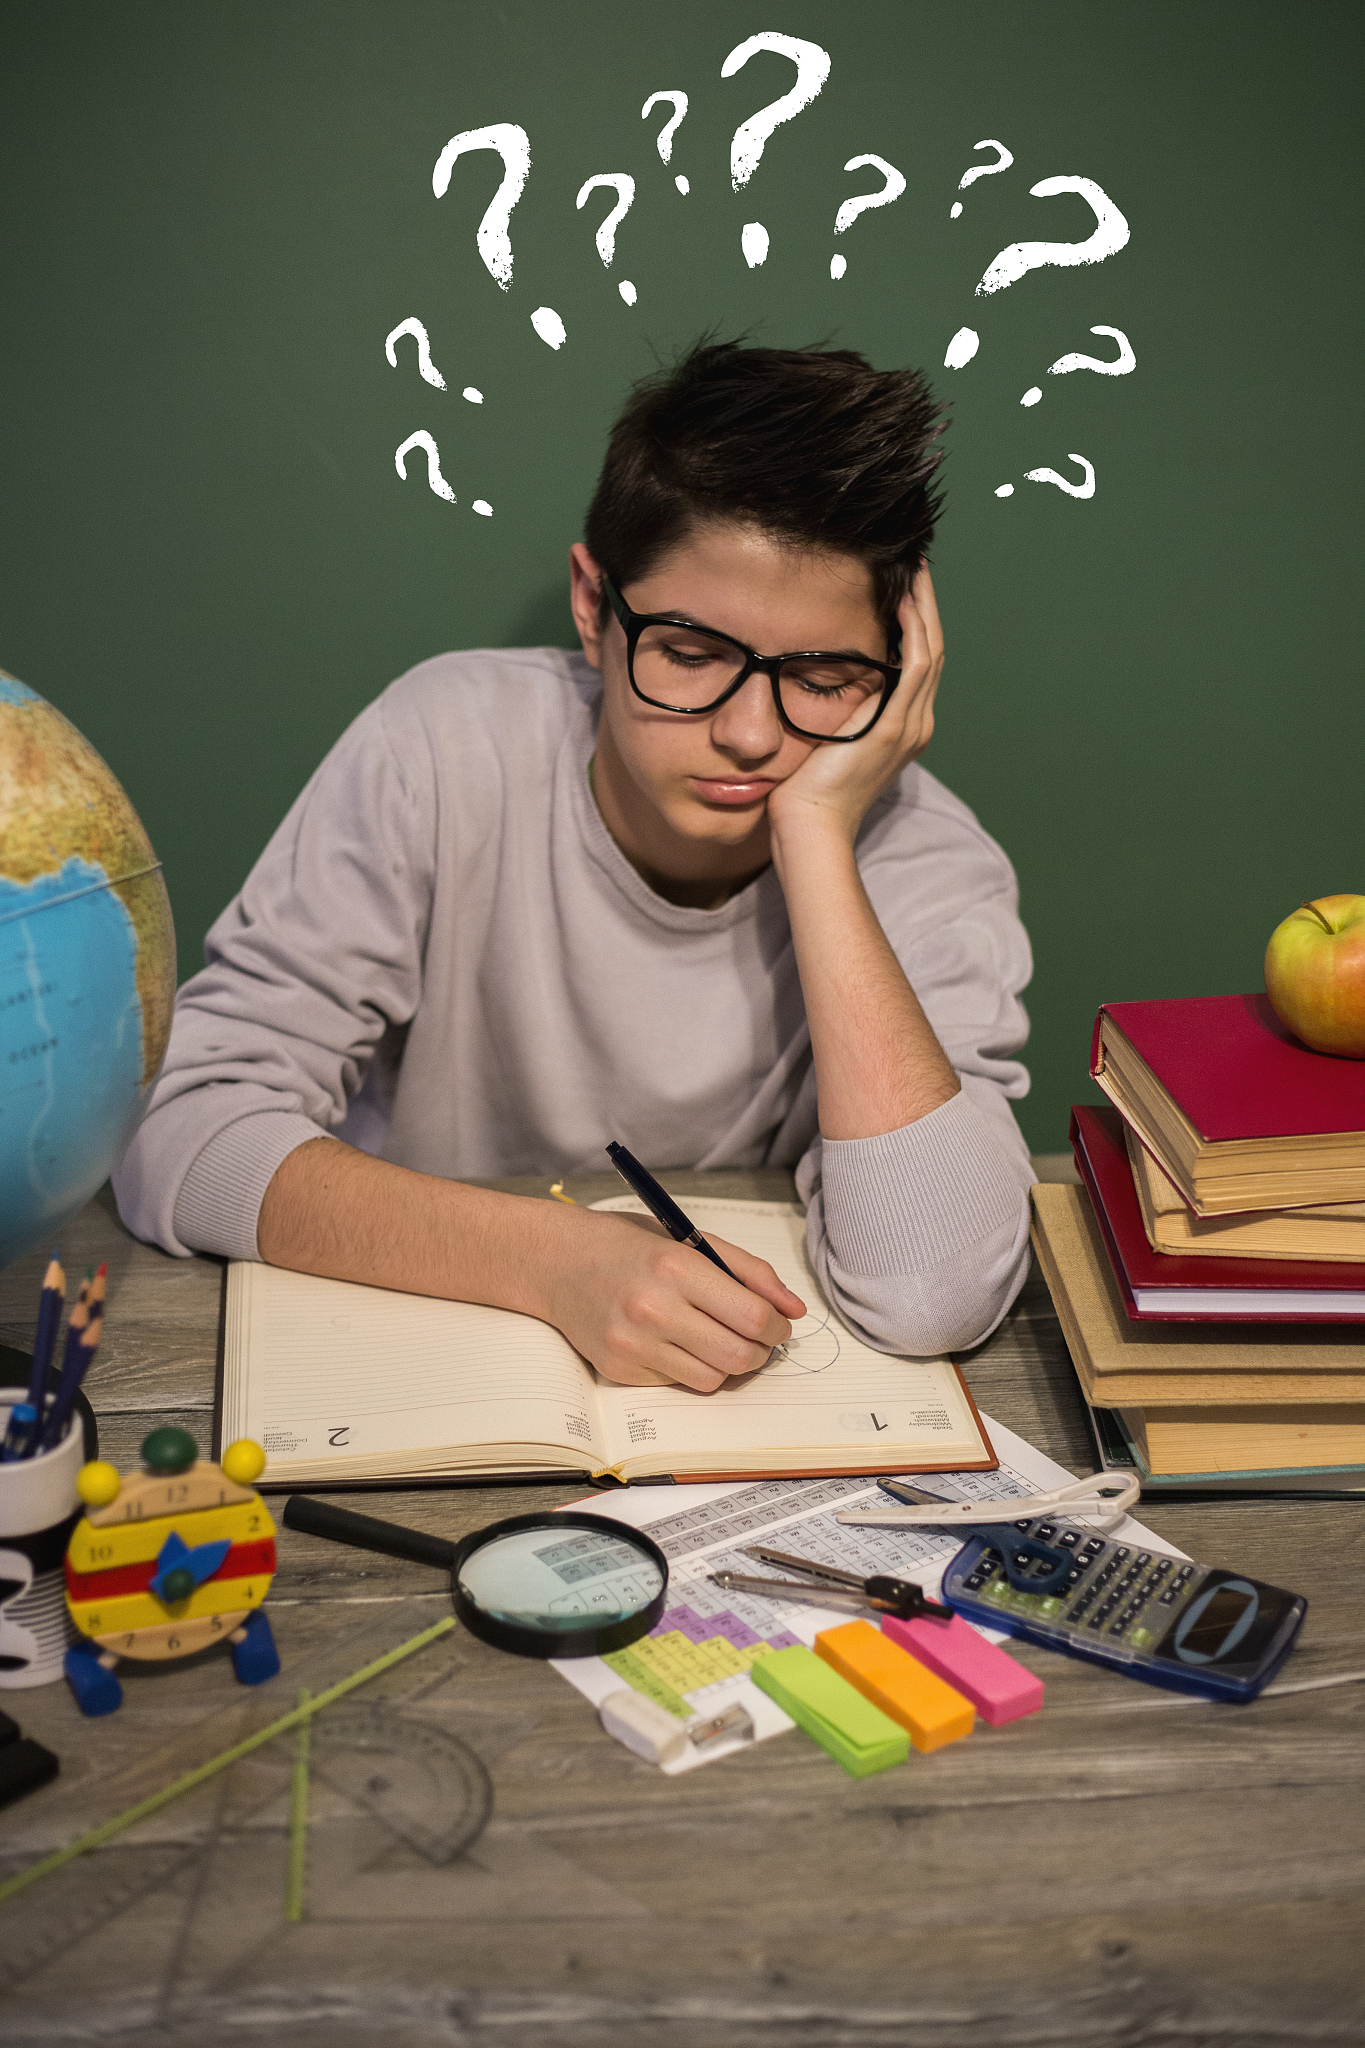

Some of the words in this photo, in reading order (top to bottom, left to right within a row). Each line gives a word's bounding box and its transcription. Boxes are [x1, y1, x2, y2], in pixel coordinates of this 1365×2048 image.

[870, 1413, 888, 1431] 1
[328, 1427, 350, 1446] 2
[167, 1485, 189, 1503] 12
[219, 1489, 226, 1504] 1
[126, 1502, 143, 1519] 11
[249, 1516, 261, 1532] 2
[90, 1546, 113, 1563] 10
[243, 1587, 254, 1599] 4
[88, 1616, 100, 1630] 8
[211, 1617, 222, 1632] 5
[125, 1633, 136, 1648] 7
[167, 1634, 180, 1649] 6
